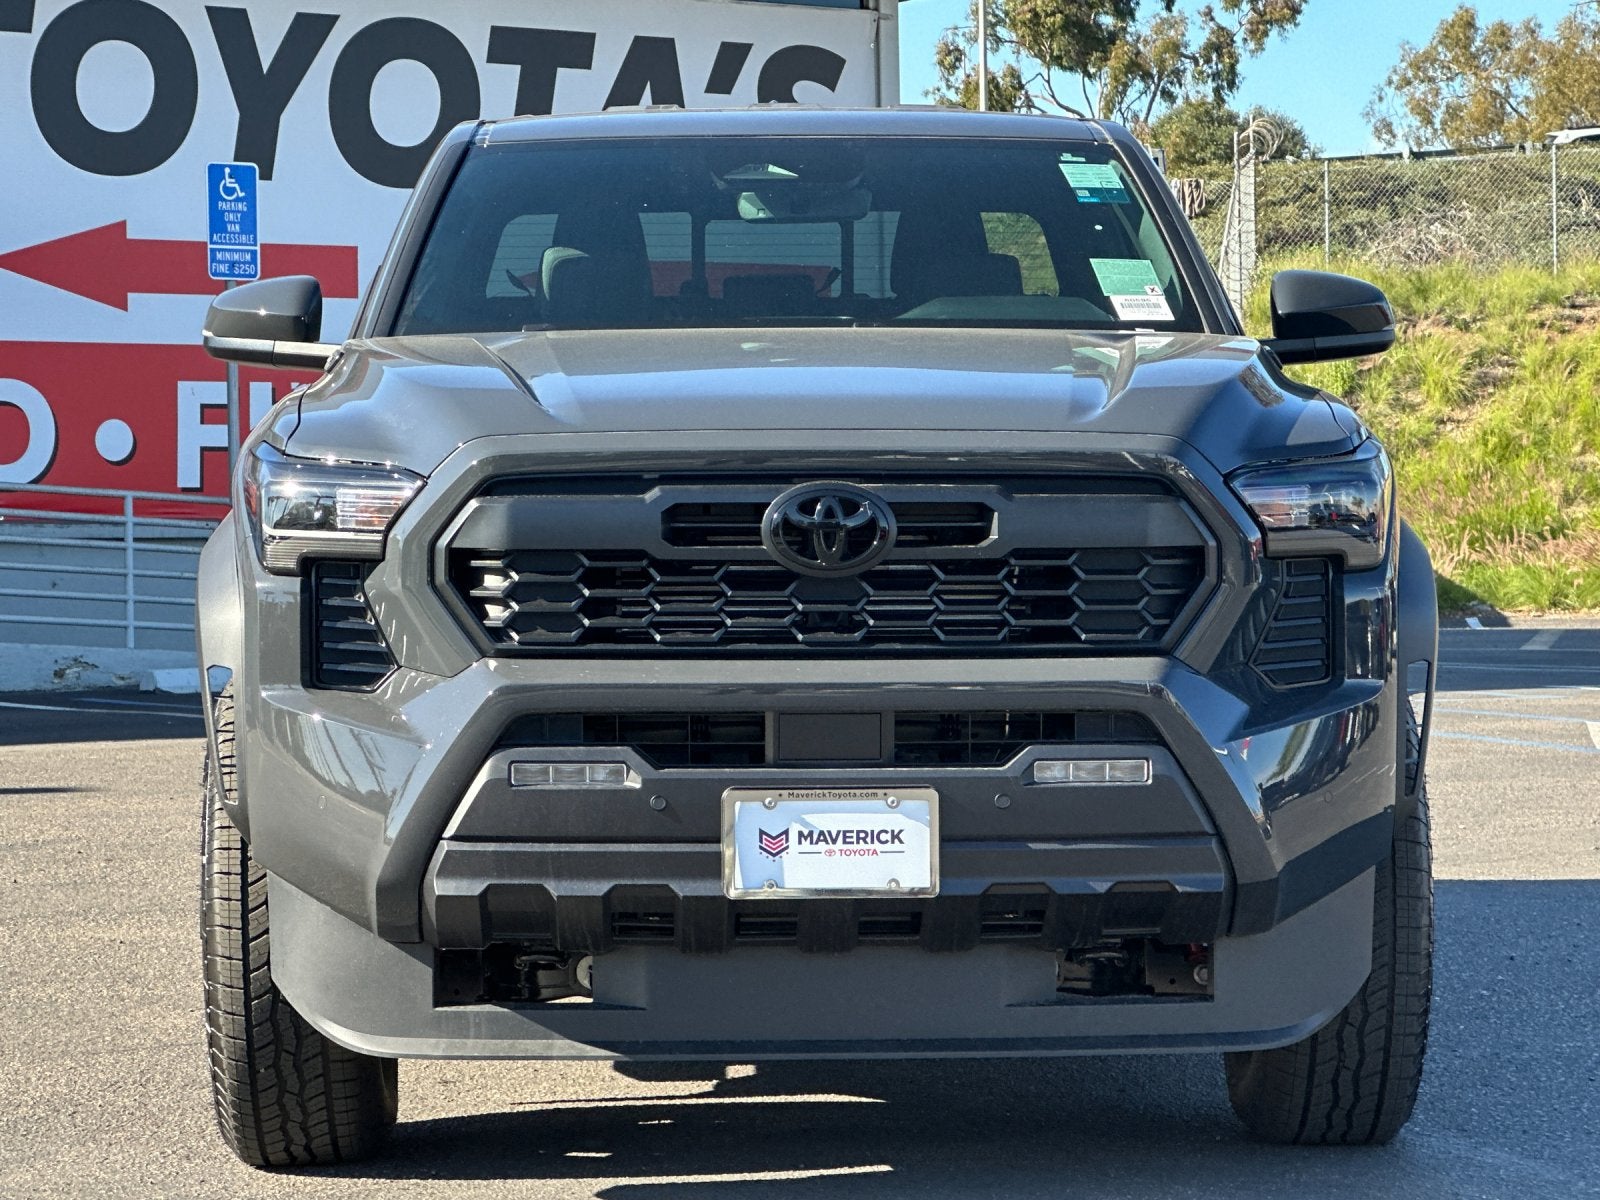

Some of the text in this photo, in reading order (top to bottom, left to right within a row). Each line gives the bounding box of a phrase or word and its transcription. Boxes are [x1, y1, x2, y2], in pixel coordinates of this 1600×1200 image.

[0, 0, 847, 187] OYOT'
[218, 201, 247, 211] PARKING
[224, 212, 242, 221] ONLY
[226, 223, 240, 233] VAN
[212, 233, 255, 244] ACCESSIBLE
[216, 251, 251, 262] MINIMUM
[211, 263, 256, 274] FINE $250
[787, 791, 879, 799] MaverickToyota.com
[797, 829, 905, 845] MAVERICK
[839, 849, 879, 857] TOYOTA
